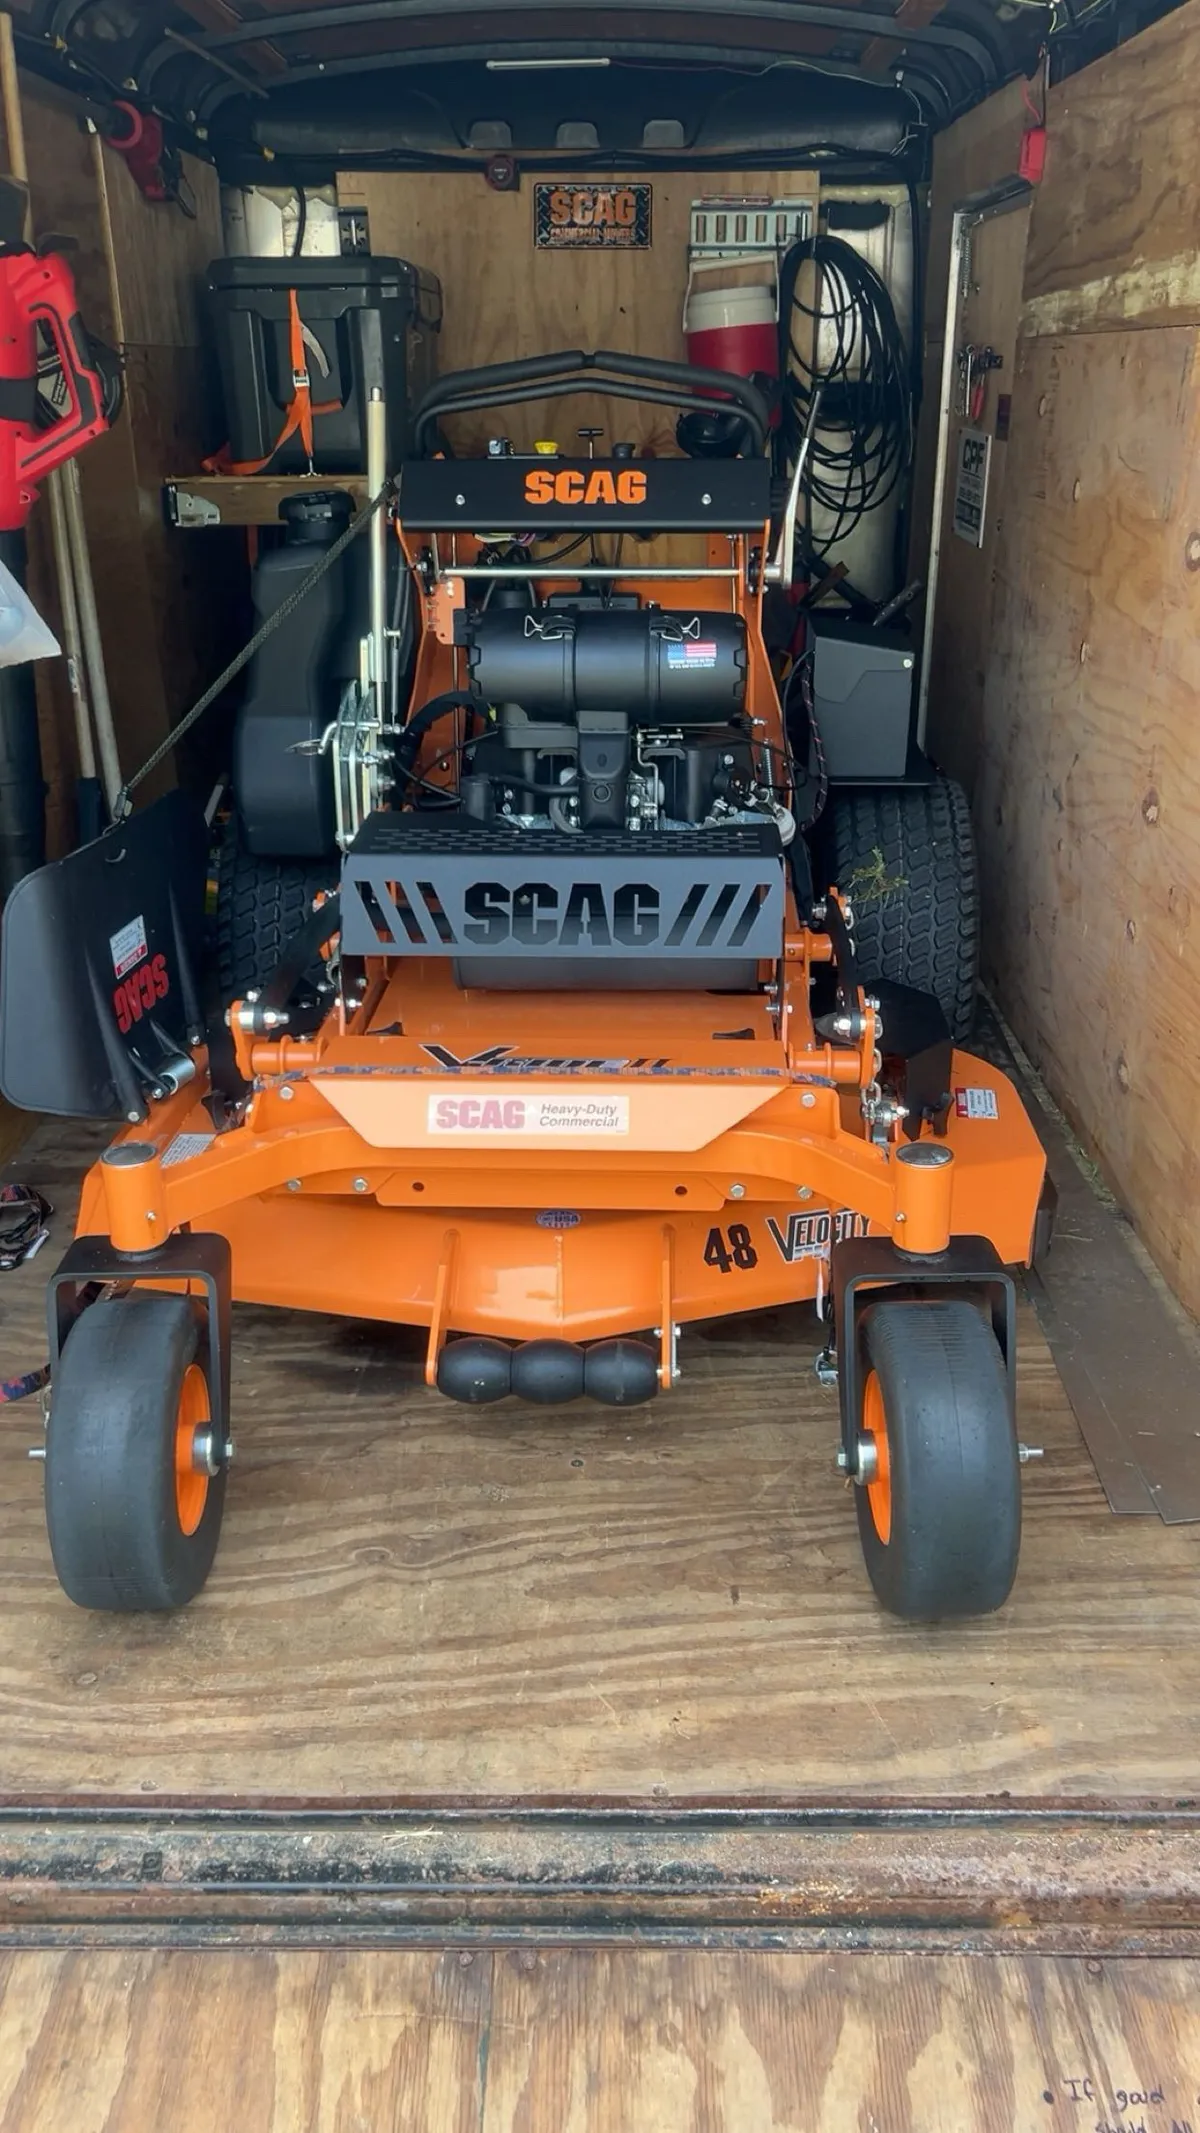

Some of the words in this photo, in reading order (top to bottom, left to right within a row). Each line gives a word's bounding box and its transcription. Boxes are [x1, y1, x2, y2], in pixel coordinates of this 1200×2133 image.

[550, 191, 637, 225] SCAG
[524, 470, 647, 504] SCAG
[463, 882, 660, 946] SCAG
[114, 953, 169, 1034] SCAG
[436, 1100, 525, 1129] SCAG
[539, 1116, 619, 1127] Commercial
[540, 1103, 618, 1117] Heavy-Duty
[703, 1223, 758, 1274] 48
[766, 1208, 871, 1263] VELOCITY
[1063, 2079, 1096, 2102] If
